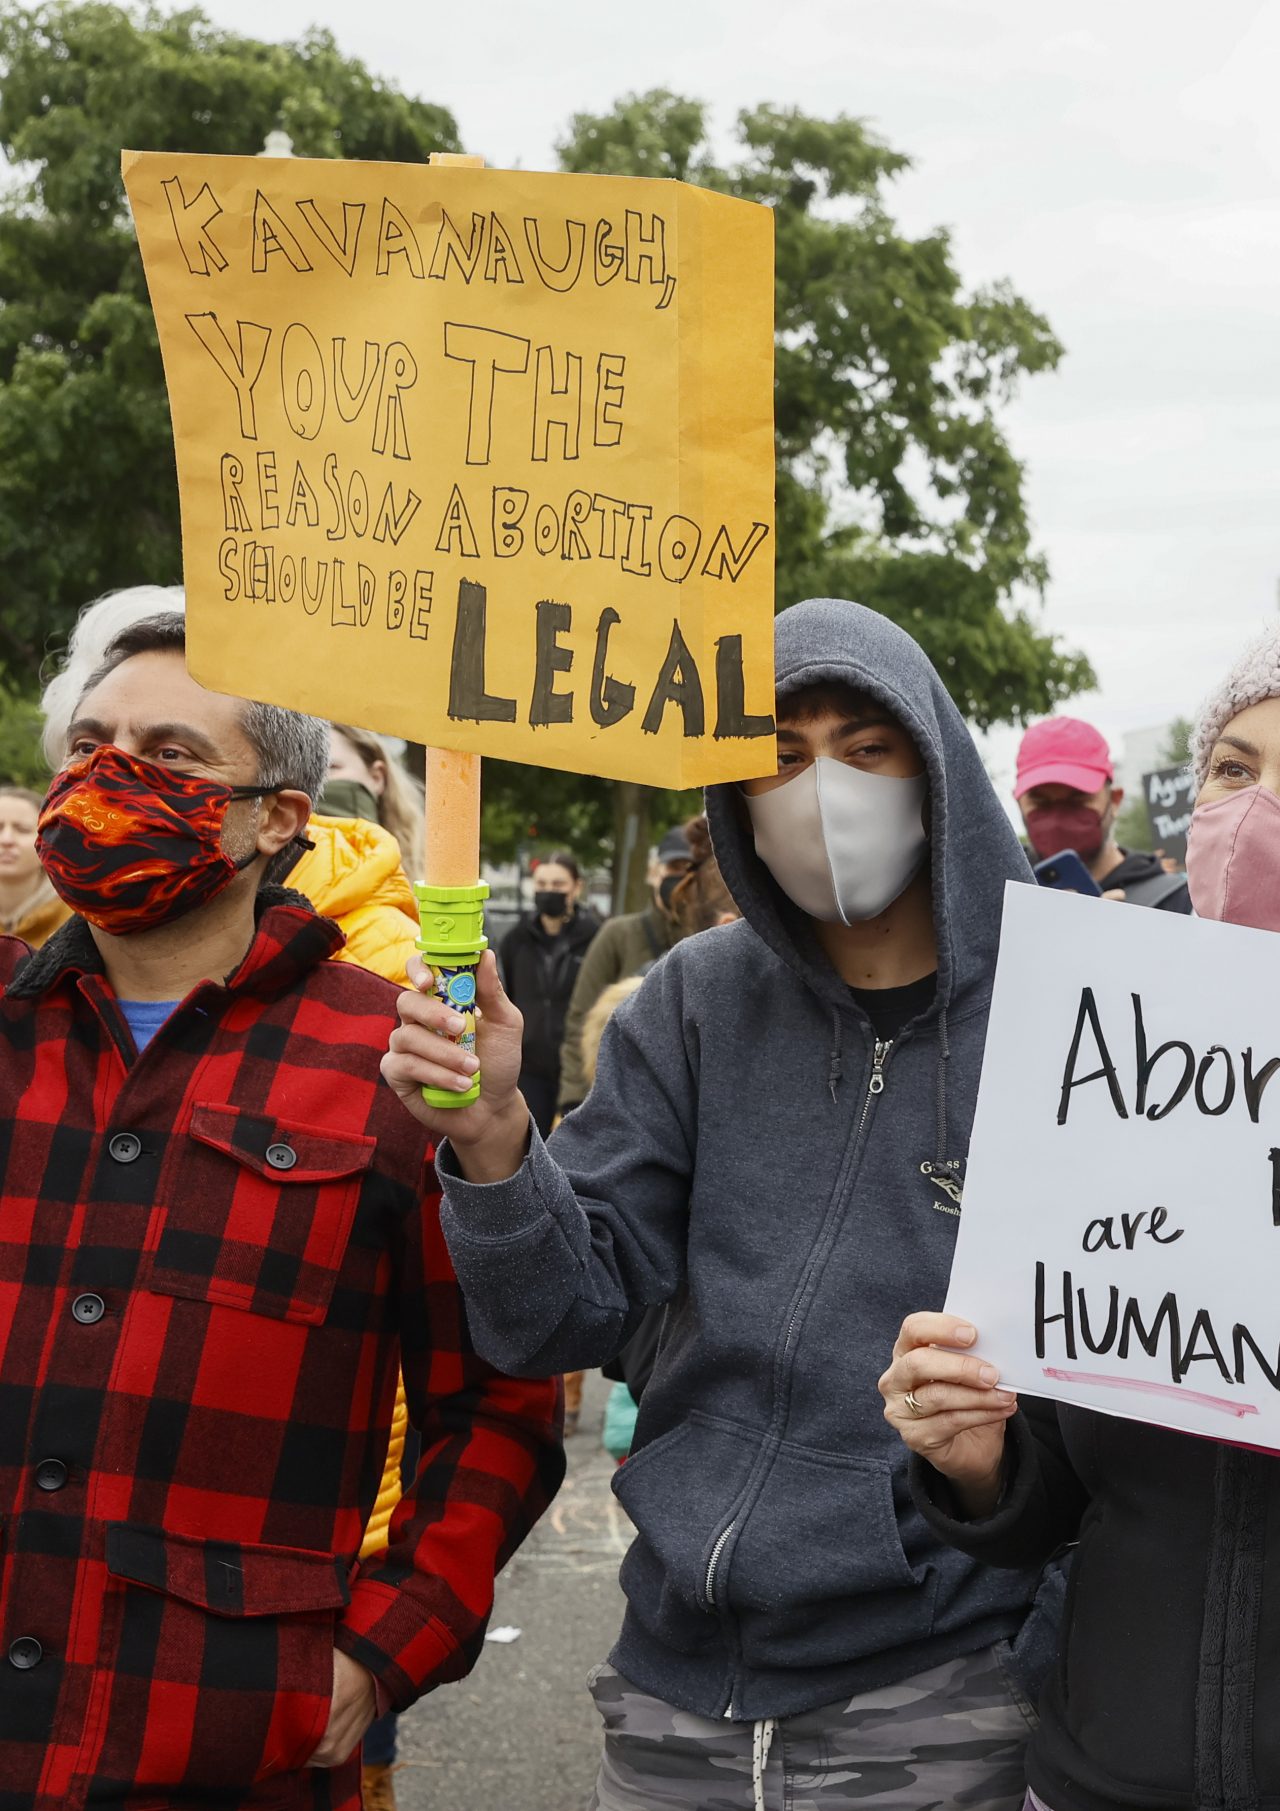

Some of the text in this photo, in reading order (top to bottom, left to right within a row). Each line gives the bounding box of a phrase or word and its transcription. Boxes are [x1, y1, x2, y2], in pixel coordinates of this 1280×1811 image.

[161, 175, 677, 309] KAVANAUGH,
[184, 311, 626, 465] YOUR THE
[219, 450, 769, 582] REASON ABORTION
[218, 537, 434, 641] SHOULD BE
[448, 576, 777, 739] LEGAL
[932, 1200, 961, 1217] Koosh
[1081, 1205, 1185, 1254] are
